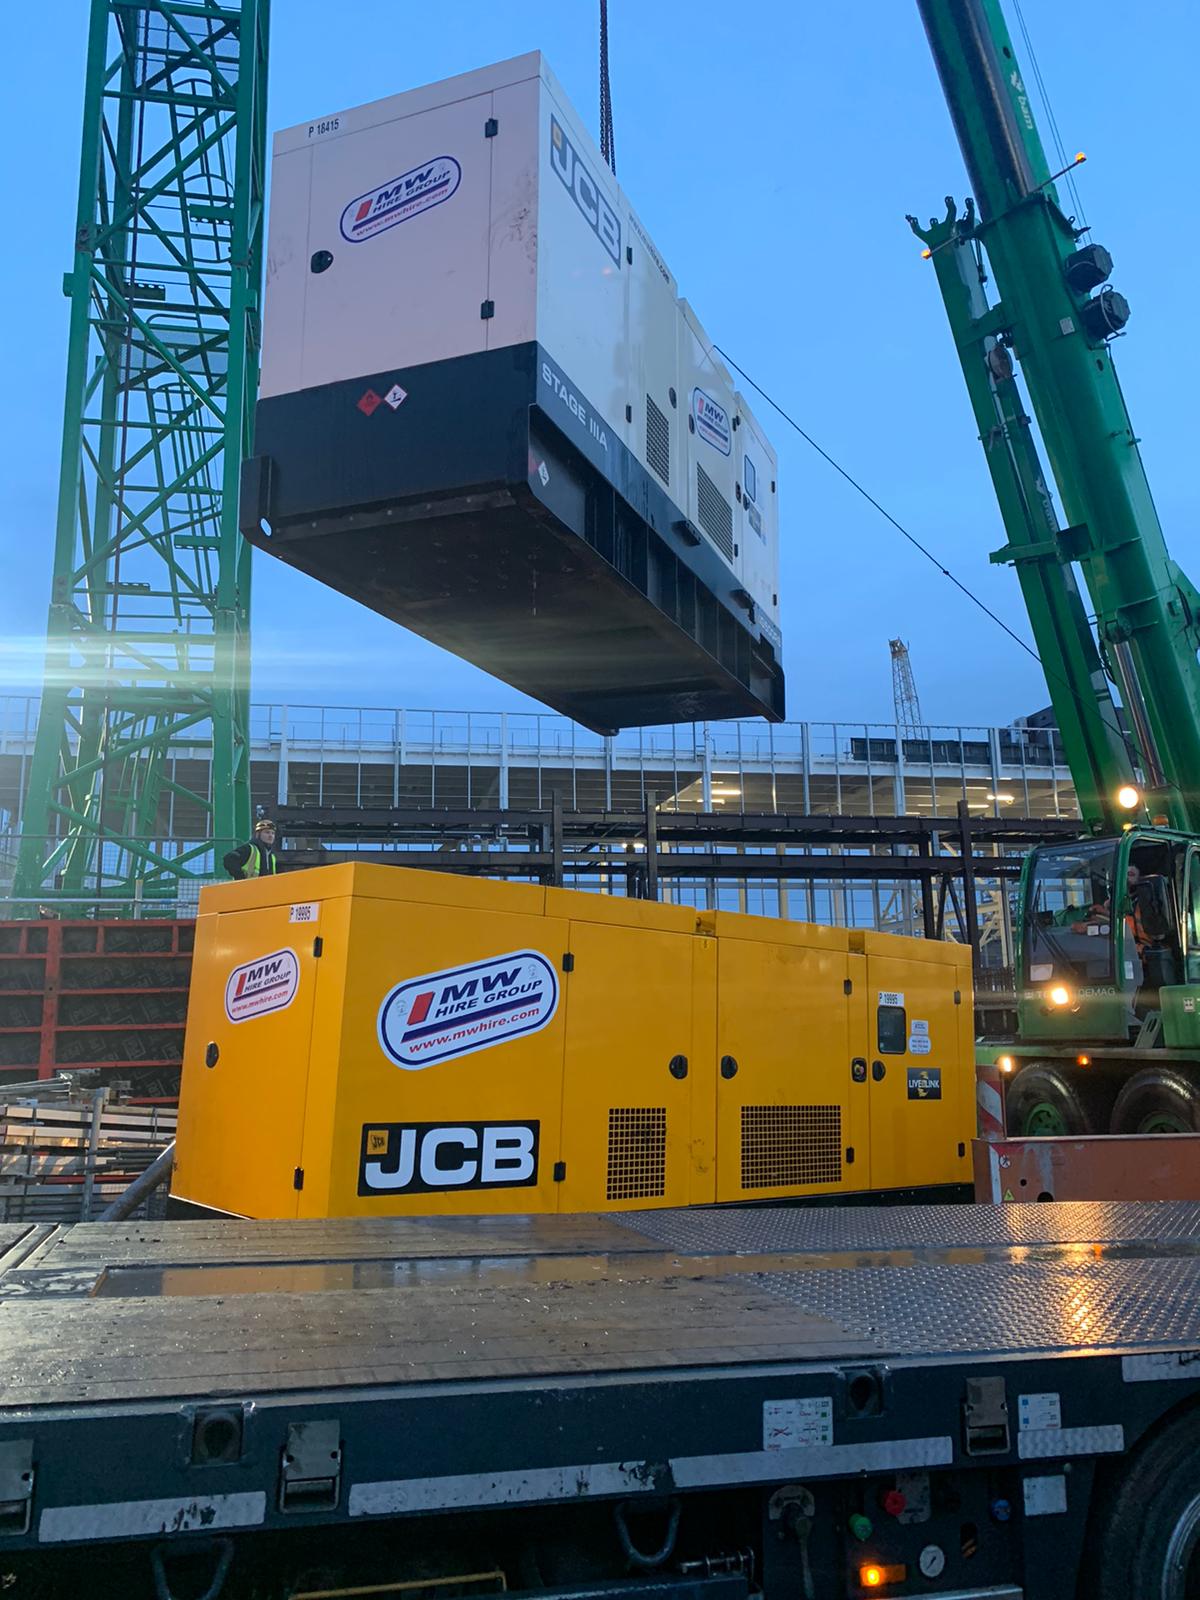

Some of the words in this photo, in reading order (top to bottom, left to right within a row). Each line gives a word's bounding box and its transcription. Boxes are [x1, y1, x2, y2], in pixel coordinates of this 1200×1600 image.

[308, 126, 314, 138] P
[317, 118, 340, 135] 18415
[372, 194, 402, 214] HIRE
[405, 170, 451, 197] GROUP
[376, 167, 435, 206] MW
[551, 142, 621, 260] JCB
[542, 363, 586, 427] STAGE
[589, 417, 608, 452] IIIA
[705, 402, 724, 423] MW
[244, 980, 263, 993] HIRE
[263, 970, 292, 986] GROUP
[247, 959, 284, 983] MW
[439, 967, 522, 1006] MW
[231, 990, 289, 1014] www.mwhire.com
[434, 997, 480, 1019] HIRE
[483, 979, 543, 1005] GROUP
[1078, 987, 1116, 997] DEMAG
[408, 1007, 540, 1054] www.mwhire.com
[365, 1126, 535, 1189] JCB
